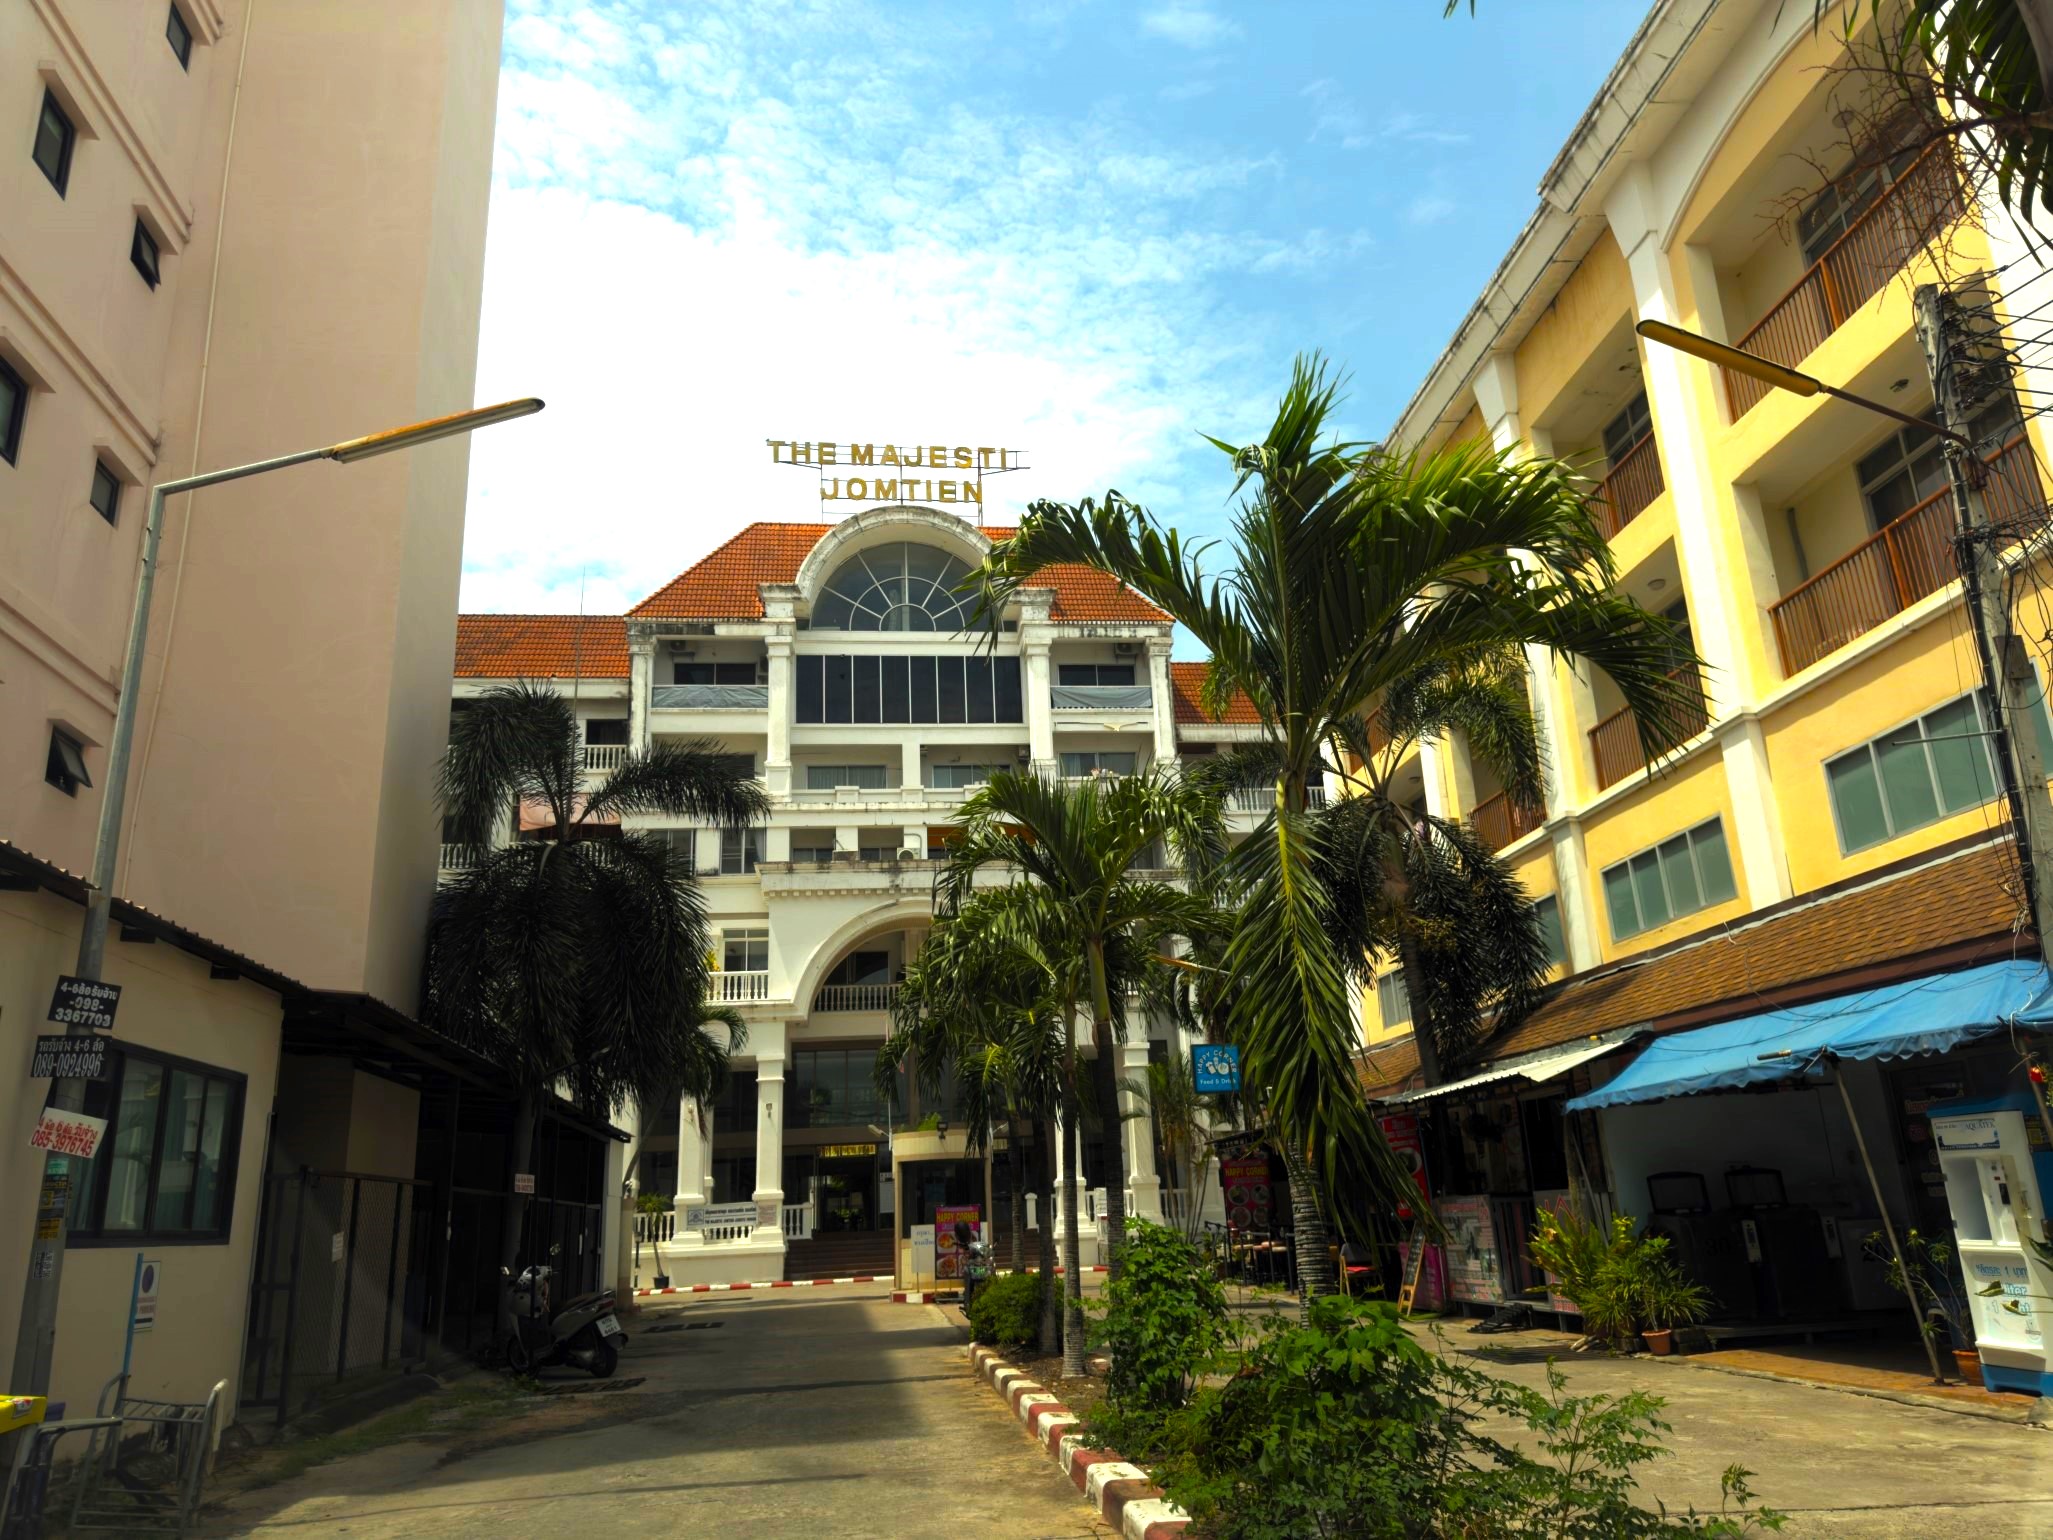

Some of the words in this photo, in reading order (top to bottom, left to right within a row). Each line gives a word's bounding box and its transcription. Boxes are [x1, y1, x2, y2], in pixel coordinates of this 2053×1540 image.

[766, 440, 836, 465] THE
[850, 443, 1008, 470] MAJESTI
[820, 477, 983, 503] JOMTIEN
[69, 996, 104, 1011] -098-
[55, 1007, 112, 1027] 3367703
[74, 1040, 90, 1052] 4-6
[33, 1053, 103, 1078] 089-0924996
[1197, 1050, 1210, 1074] HAPPY
[31, 1129, 94, 1156] 085-3976745
[936, 1211, 954, 1222] HAPPY
[2001, 1283, 2027, 1296] iter
